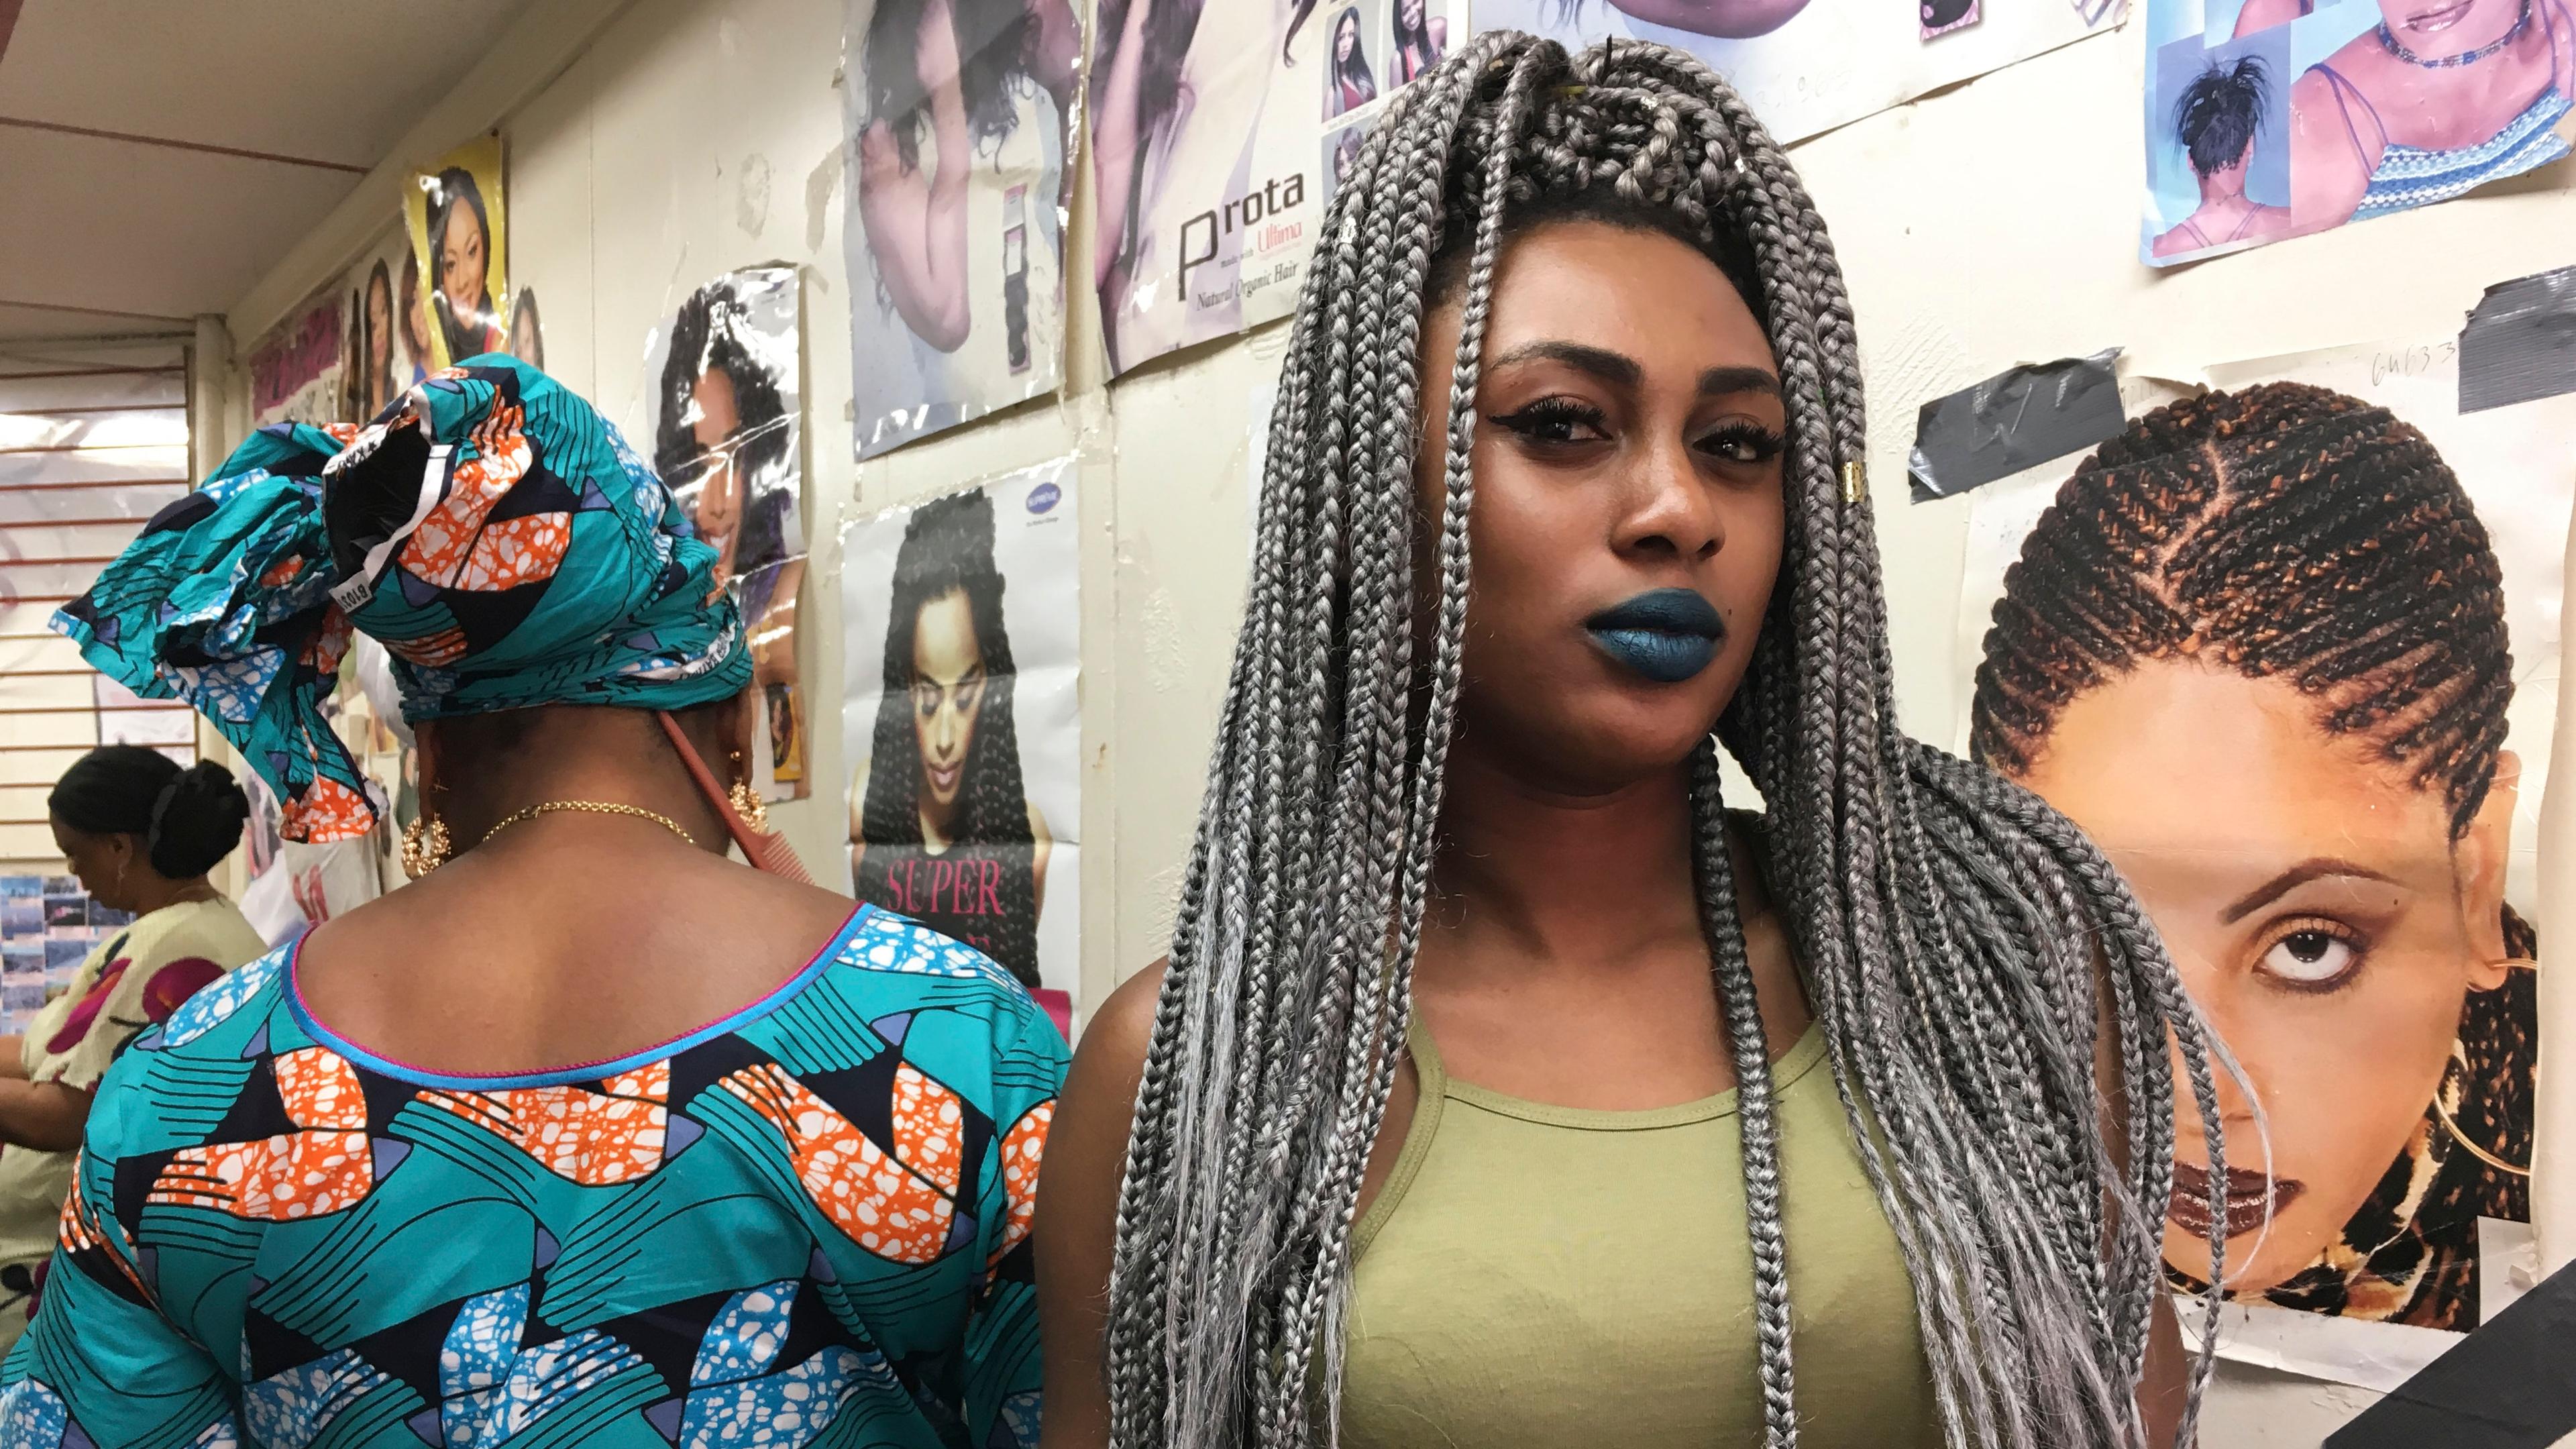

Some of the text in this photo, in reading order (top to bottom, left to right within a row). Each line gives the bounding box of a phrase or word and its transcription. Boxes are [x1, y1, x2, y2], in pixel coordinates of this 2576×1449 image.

[1197, 260, 1299, 311] Natural Organic Hair
[886, 859, 1006, 916] SUPER
